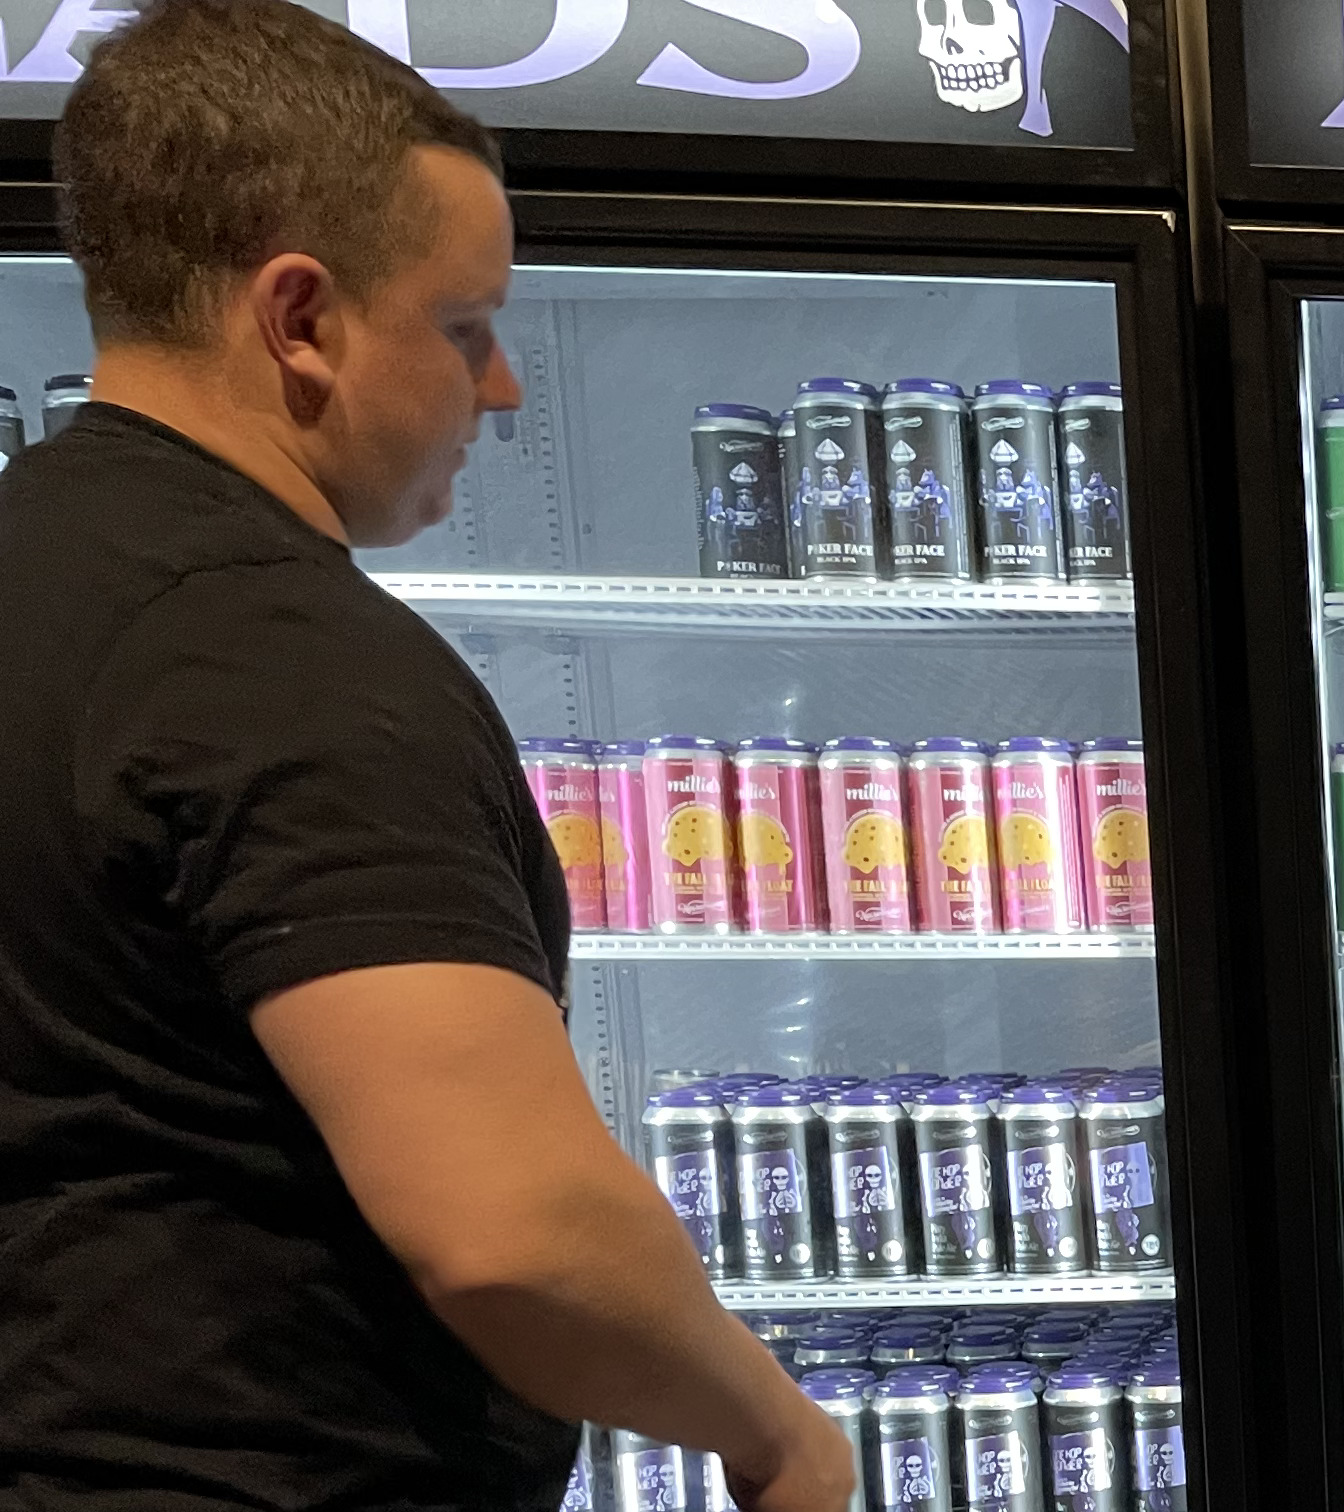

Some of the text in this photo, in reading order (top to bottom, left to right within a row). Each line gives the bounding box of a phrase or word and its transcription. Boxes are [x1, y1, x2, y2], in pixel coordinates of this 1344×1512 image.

[844, 543, 874, 556] FACE
[916, 545, 945, 556] FACE
[1018, 545, 1047, 557] FACE
[1086, 547, 1113, 557] FACE
